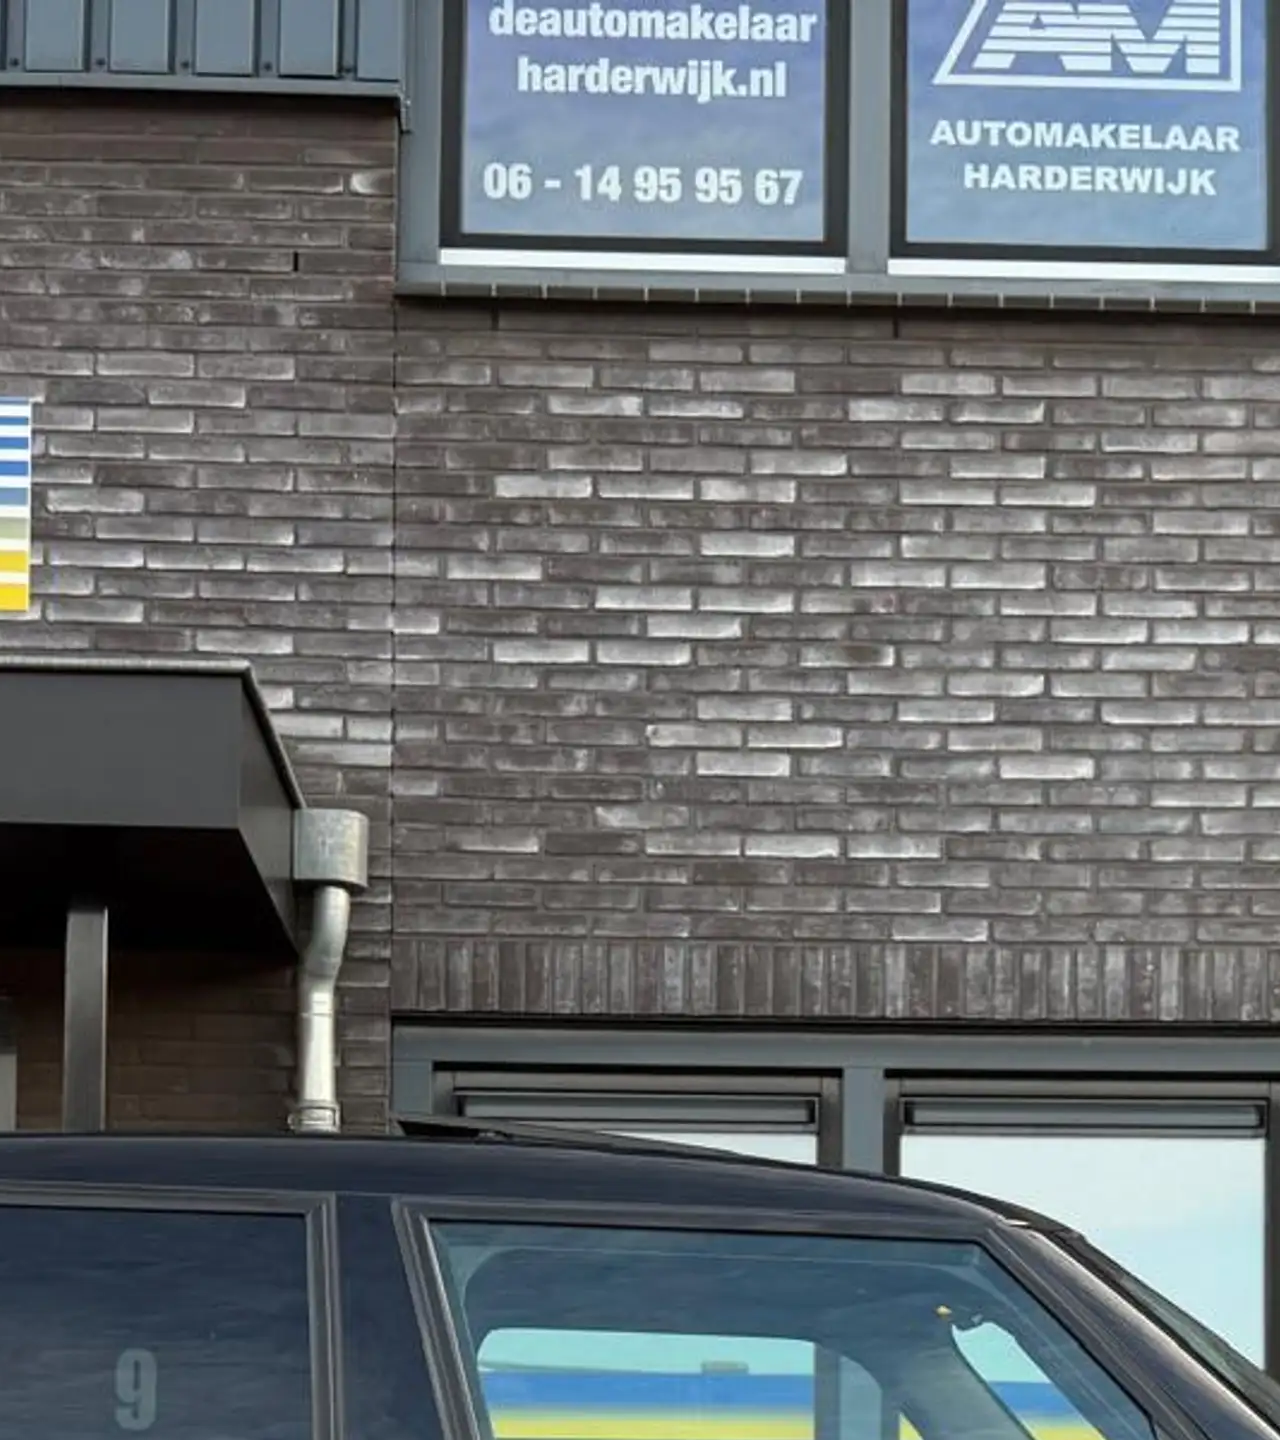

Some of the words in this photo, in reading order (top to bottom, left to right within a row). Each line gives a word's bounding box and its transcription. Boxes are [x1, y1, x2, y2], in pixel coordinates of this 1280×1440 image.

[489, 1, 817, 42] deautomakelaar
[518, 55, 787, 104] harderwijk.nl
[930, 120, 1241, 152] AUTOMAKELAAR
[483, 162, 532, 200] 06
[575, 164, 622, 202] 14
[634, 166, 683, 203] 95
[695, 167, 742, 204] 95
[755, 169, 803, 205] 67
[963, 162, 1217, 196] HARDERWIJK
